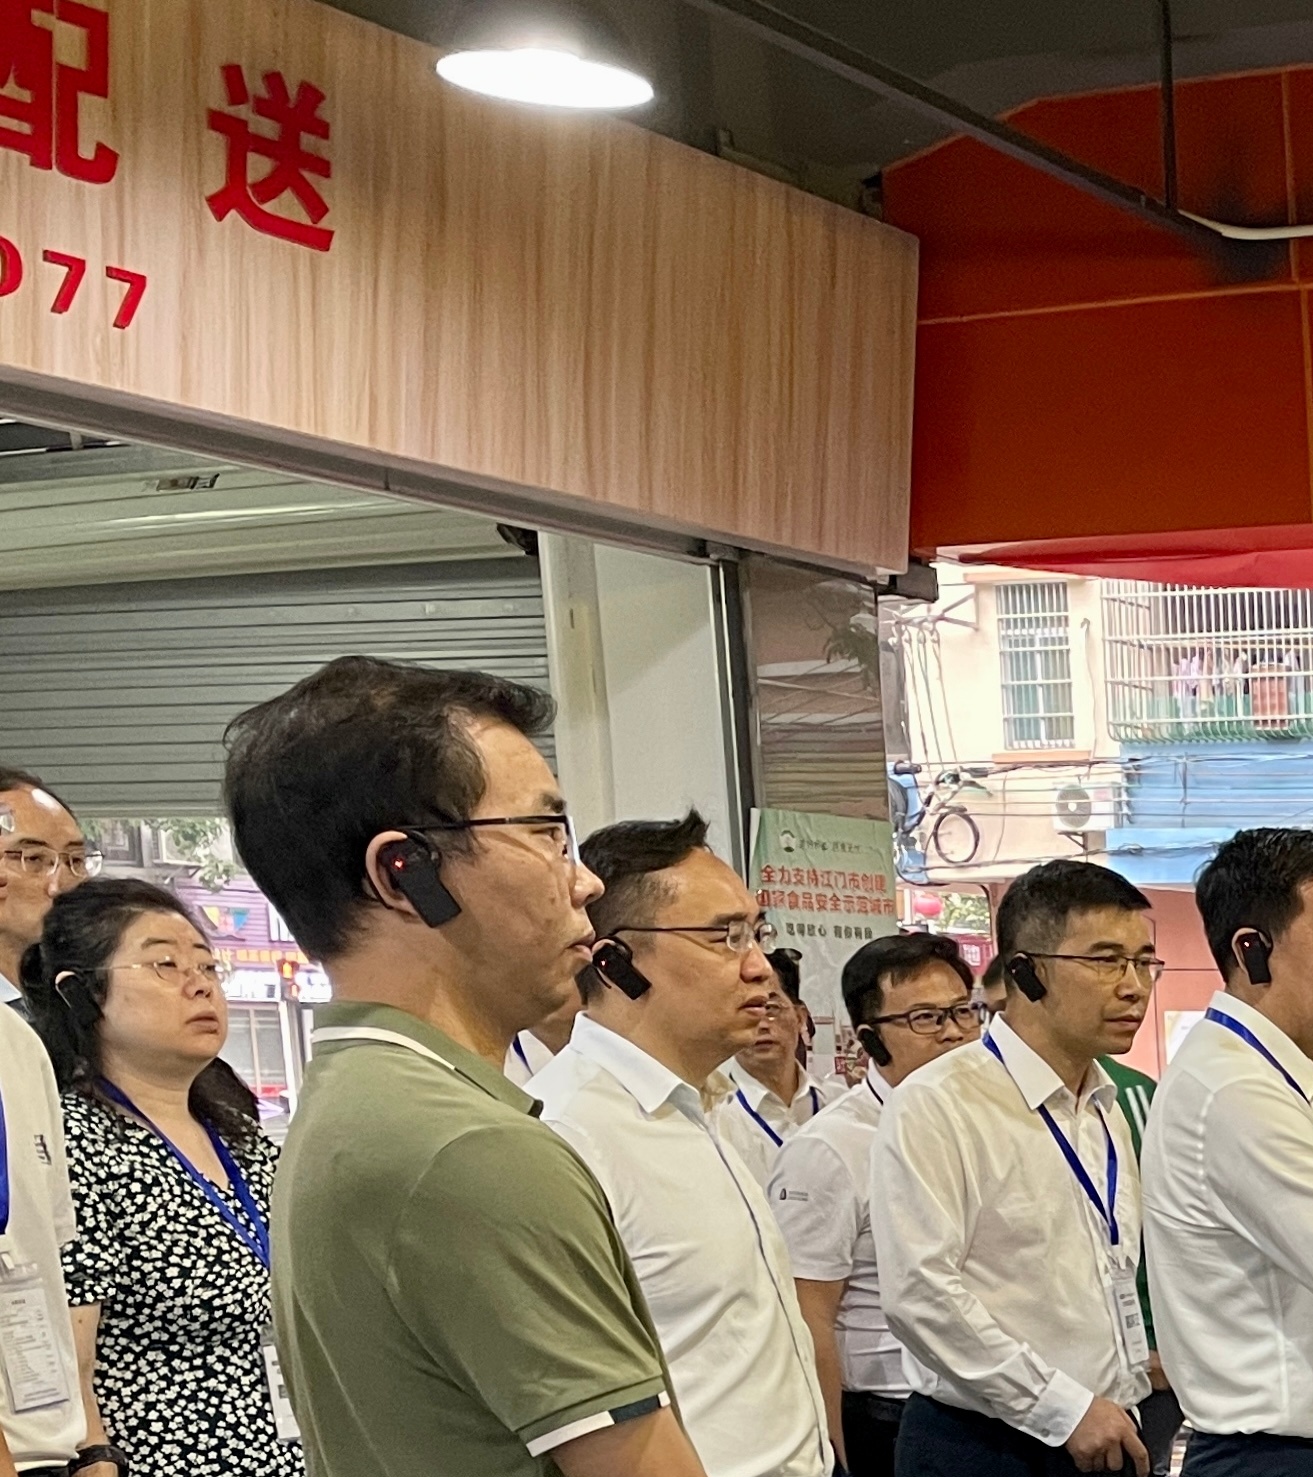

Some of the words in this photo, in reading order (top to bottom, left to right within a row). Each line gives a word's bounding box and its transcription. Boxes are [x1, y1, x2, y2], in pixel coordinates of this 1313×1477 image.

[761, 864, 887, 894] 全力支持江门市创建
